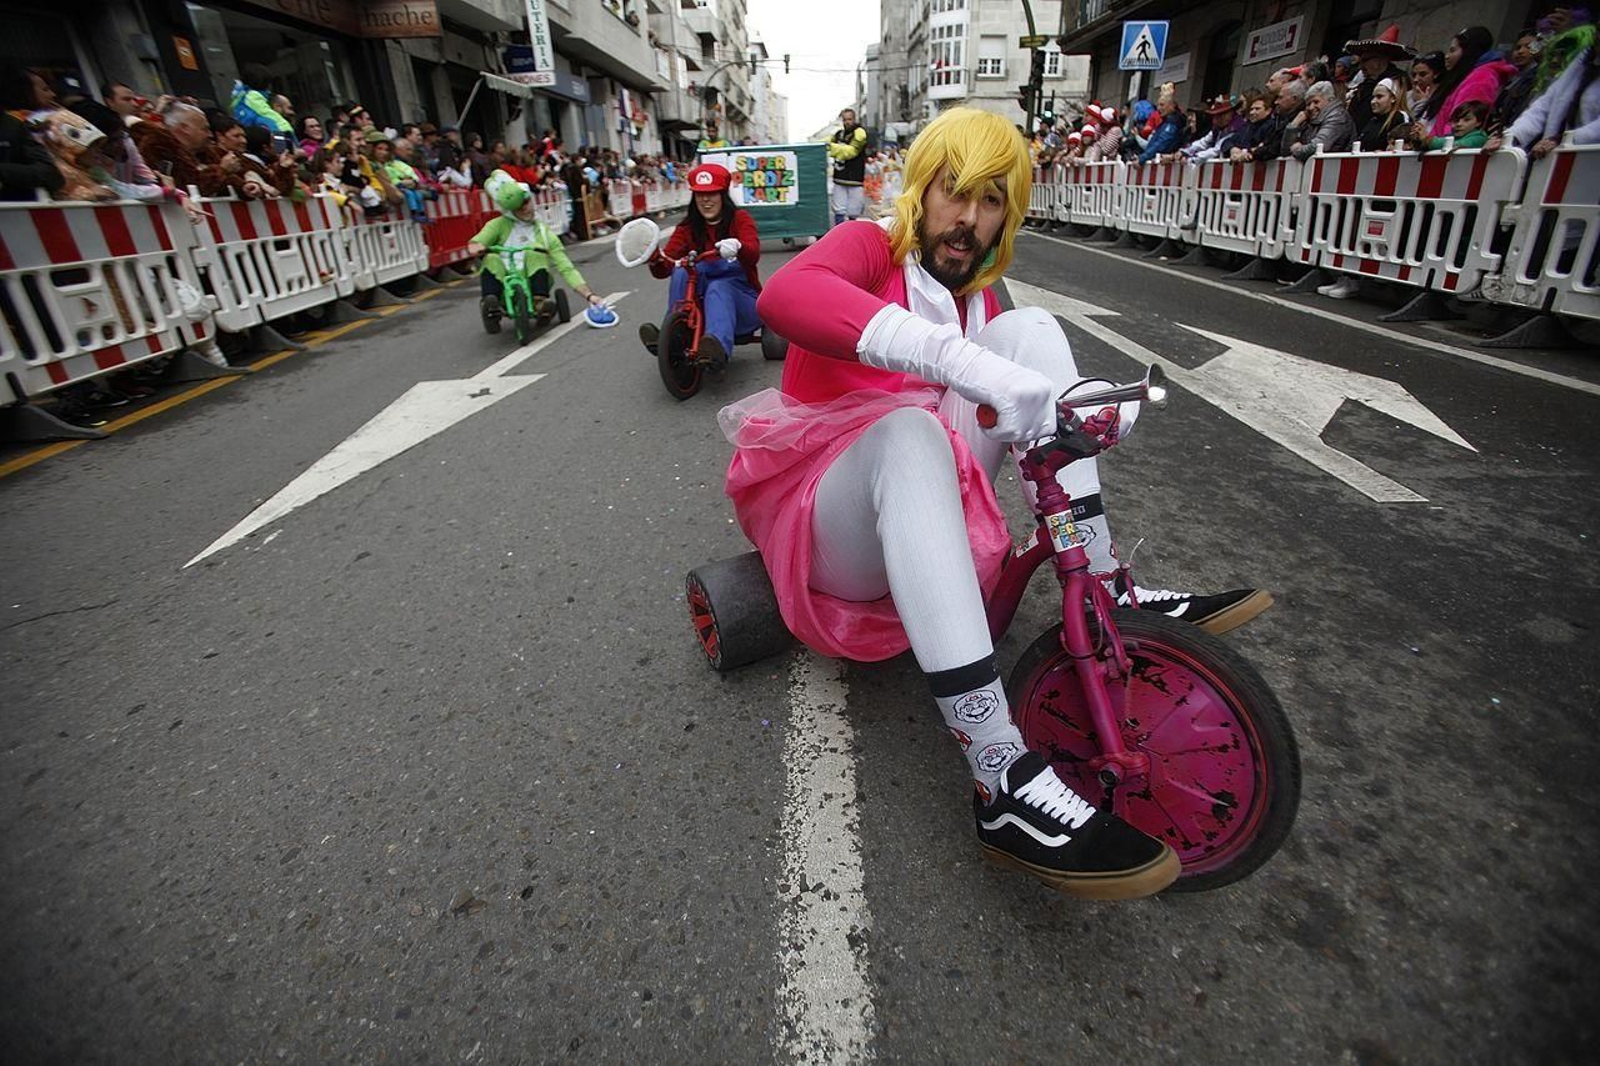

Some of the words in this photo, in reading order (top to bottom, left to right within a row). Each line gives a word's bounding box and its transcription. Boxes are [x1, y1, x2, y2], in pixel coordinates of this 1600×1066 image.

[362, 5, 433, 27] hache
[735, 155, 786, 171] SUPER
[730, 169, 795, 188] PERDIZ
[743, 186, 789, 203] KART
